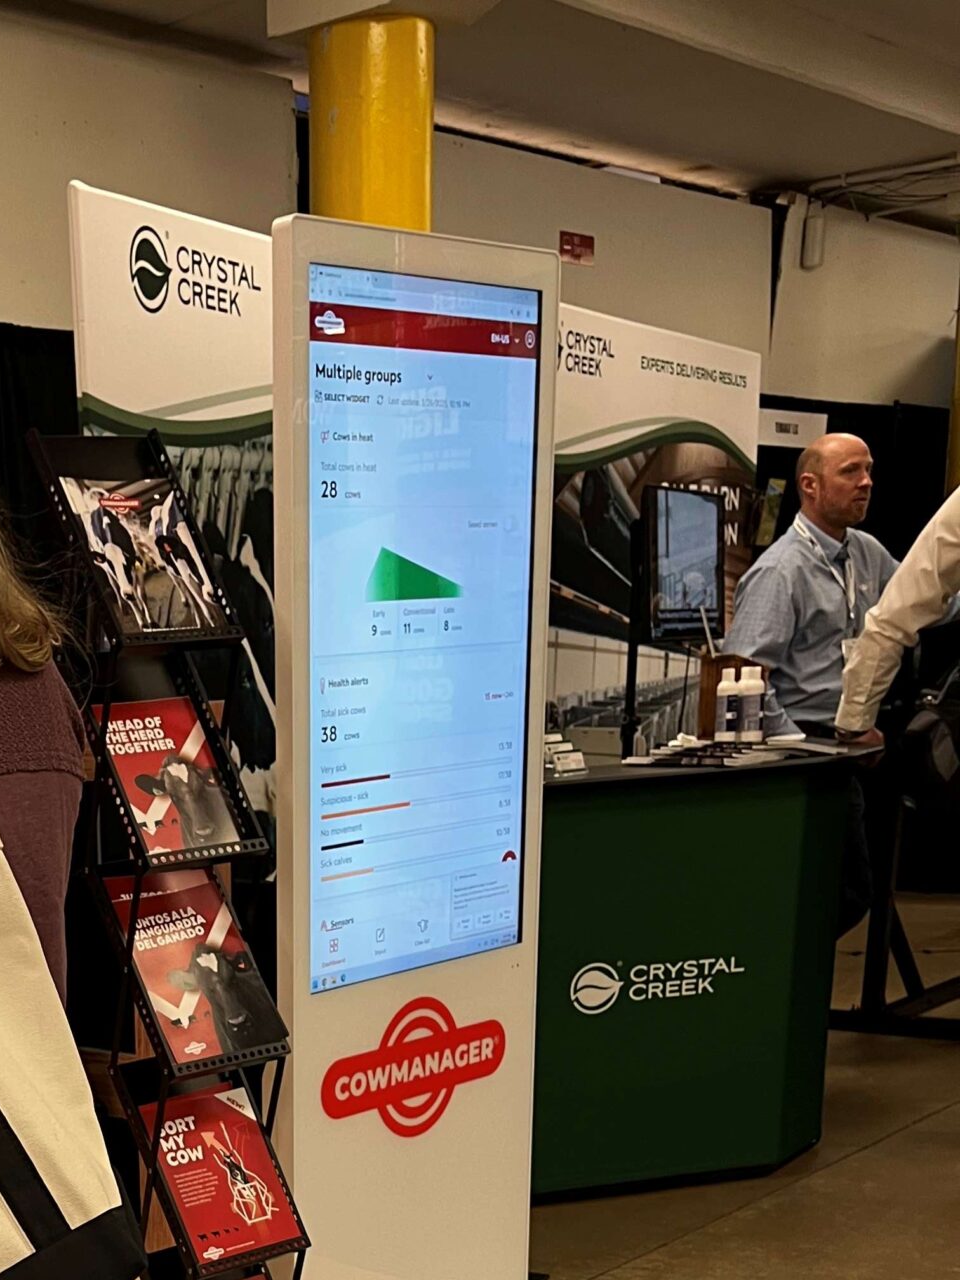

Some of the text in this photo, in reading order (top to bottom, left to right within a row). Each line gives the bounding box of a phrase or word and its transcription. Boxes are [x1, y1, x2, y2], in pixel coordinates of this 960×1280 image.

[176, 245, 261, 291] CRYSTAL
[177, 277, 241, 317] CREEK
[566, 330, 615, 359] CRYSTAL
[565, 352, 602, 378] CREEK
[641, 356, 747, 388] EXPERTS DELIVERING RESULTS
[315, 364, 402, 386] Multiple groups
[324, 393, 370, 403] SELECT WIDGET
[332, 432, 374, 442] Cows in heat
[320, 462, 377, 472] Total cows in heat
[320, 480, 338, 499] 28
[371, 624, 378, 636] 9
[403, 623, 411, 634] 11
[443, 620, 449, 631] 8
[328, 677, 369, 688] Health alerts
[321, 707, 366, 718] Total sick cows
[108, 716, 162, 732] HEAD OF
[128, 728, 164, 742] HERD
[320, 725, 337, 743] 38
[107, 738, 176, 756] TOGETHER
[320, 829, 329, 837] No
[330, 824, 362, 836] movement
[320, 856, 353, 868] Sick calves
[135, 906, 197, 929] UNTOS A LA
[330, 917, 354, 929] Sensors
[136, 926, 205, 951] DEL GANADO
[630, 956, 745, 983] CRYSTAL
[628, 977, 714, 1001] CREEK
[334, 1036, 495, 1101] COWMANAGER
[160, 1133, 185, 1152] MY
[166, 1145, 204, 1166] COW
